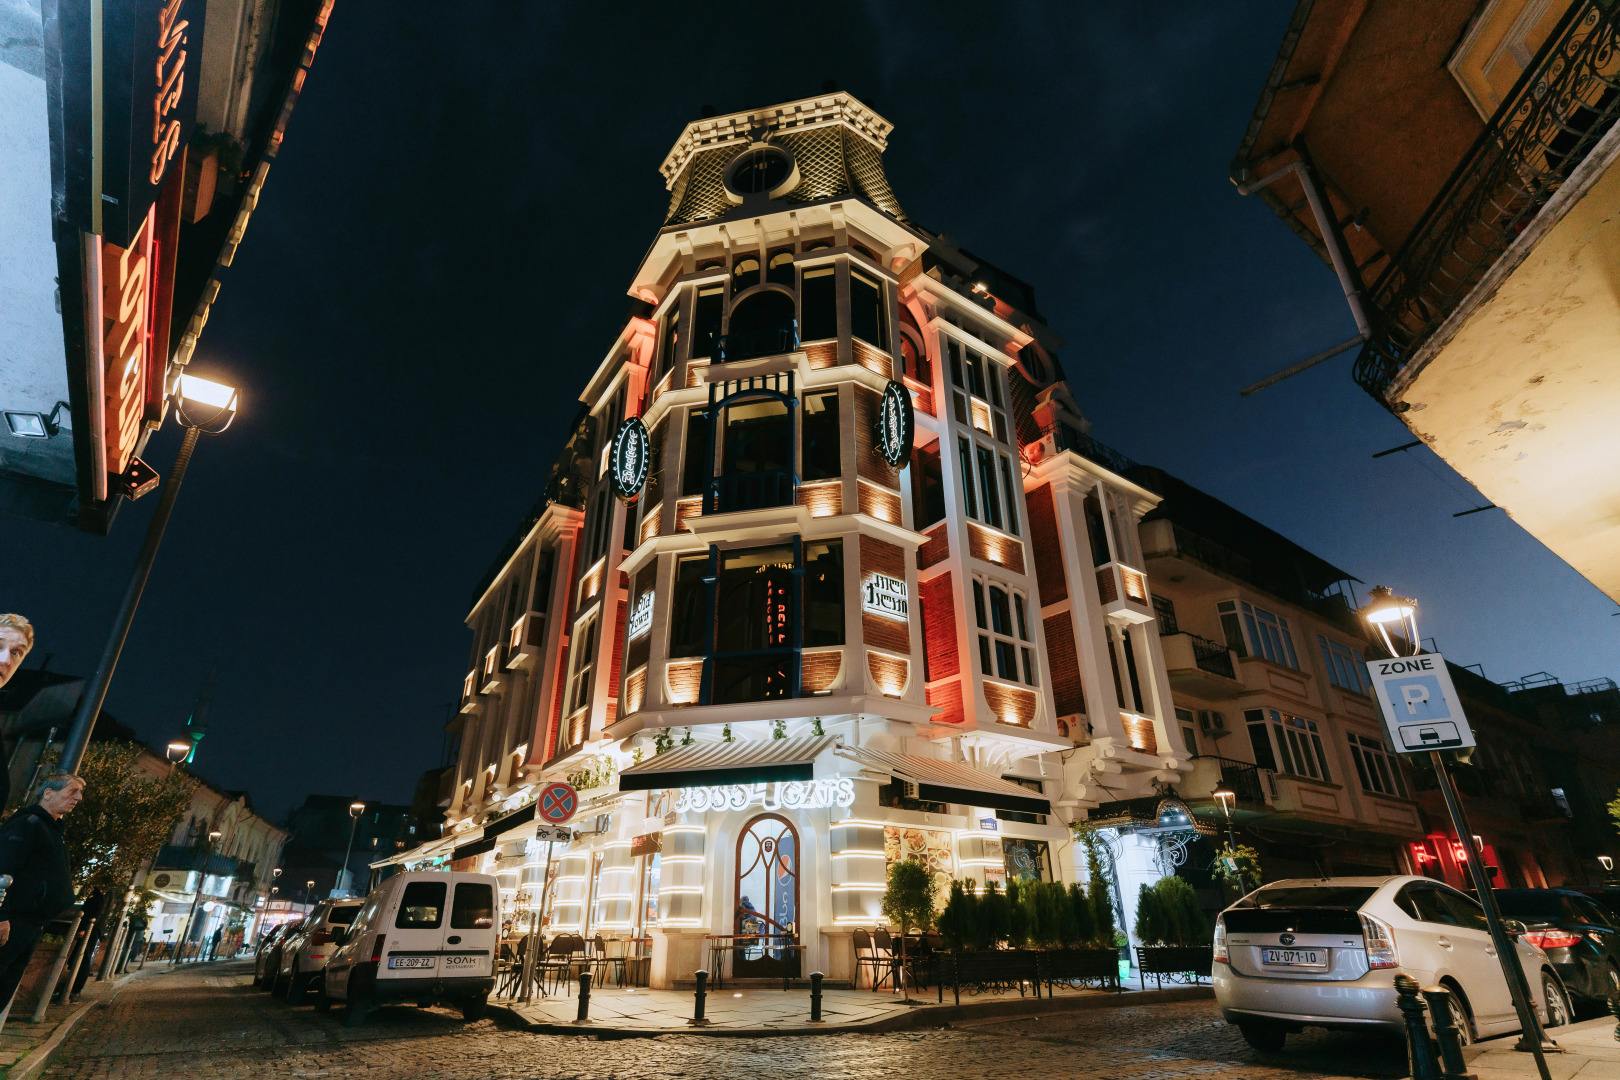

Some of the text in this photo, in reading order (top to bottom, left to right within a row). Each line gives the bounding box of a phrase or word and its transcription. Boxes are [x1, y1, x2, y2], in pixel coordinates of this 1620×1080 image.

[118, 342, 142, 475] CLUB
[1378, 658, 1435, 676] ZONE
[1400, 684, 1430, 715] P
[780, 778, 856, 809] CATS
[394, 957, 431, 967] EE-209-ZZ
